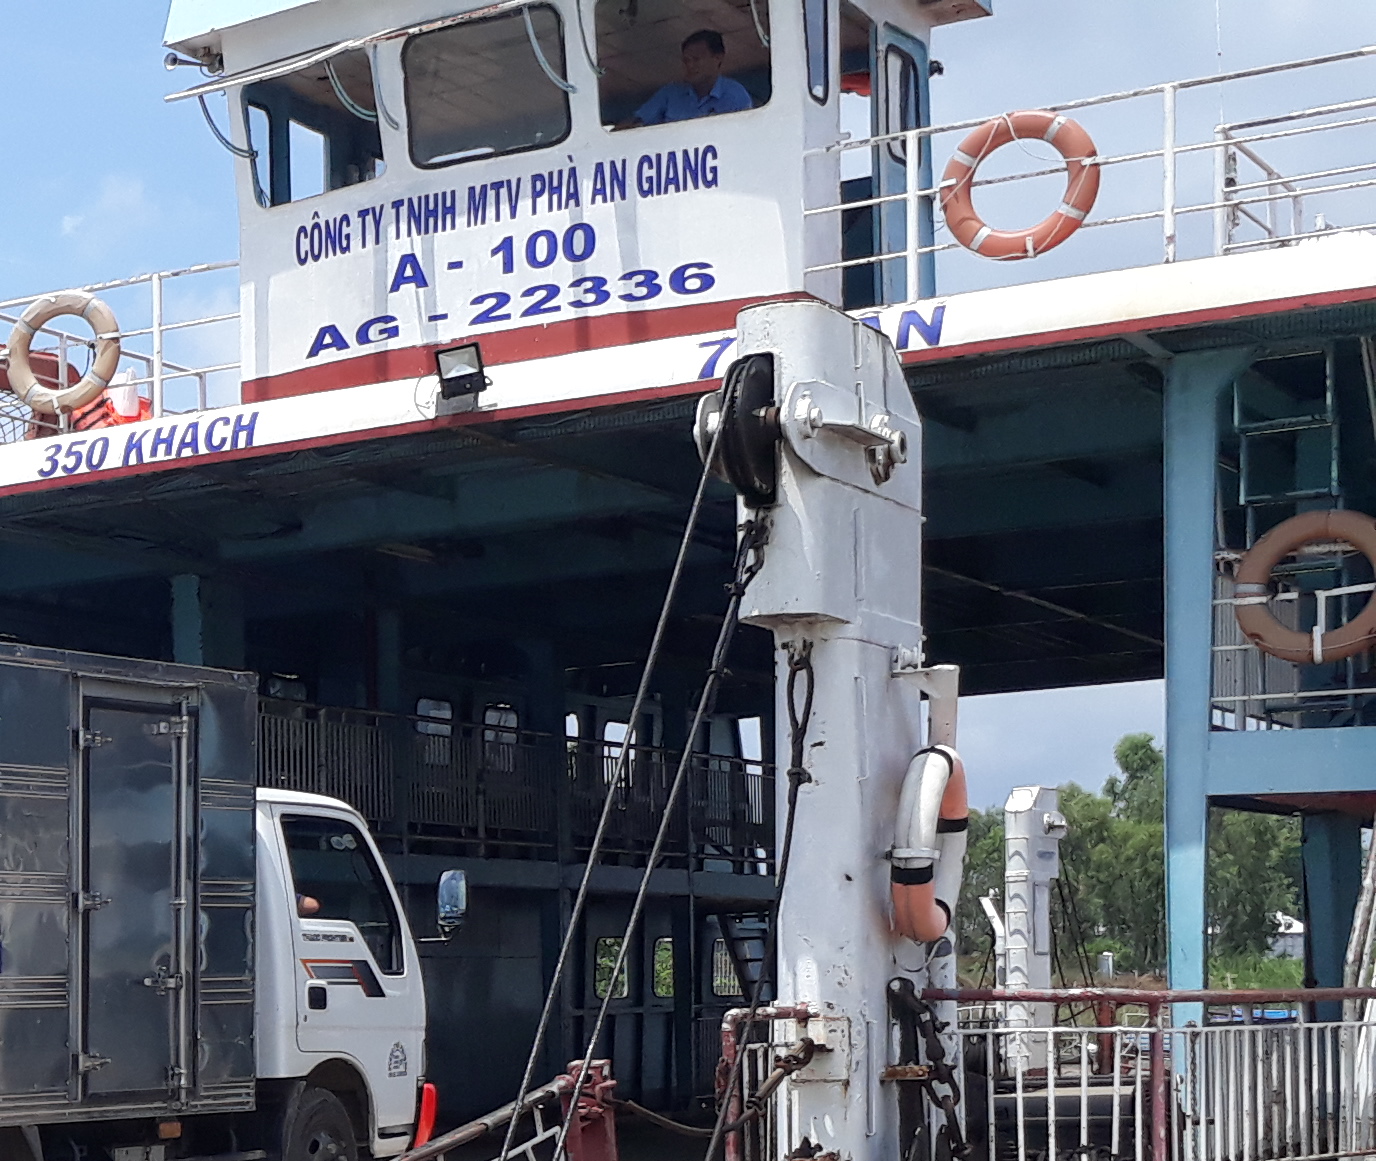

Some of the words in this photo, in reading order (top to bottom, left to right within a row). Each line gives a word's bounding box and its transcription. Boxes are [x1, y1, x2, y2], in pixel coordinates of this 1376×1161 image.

[296, 213, 351, 266] CÔNG
[358, 203, 386, 250] TY
[391, 189, 456, 240] TNHH
[466, 177, 522, 229] MTV
[531, 155, 579, 214] PHÀ
[590, 158, 627, 205] AN
[636, 144, 719, 198] GIANG
[389, 252, 429, 293] A
[491, 222, 596, 274] 100
[306, 314, 400, 359] AG
[468, 262, 716, 327] 22336
[38, 436, 110, 478] 350
